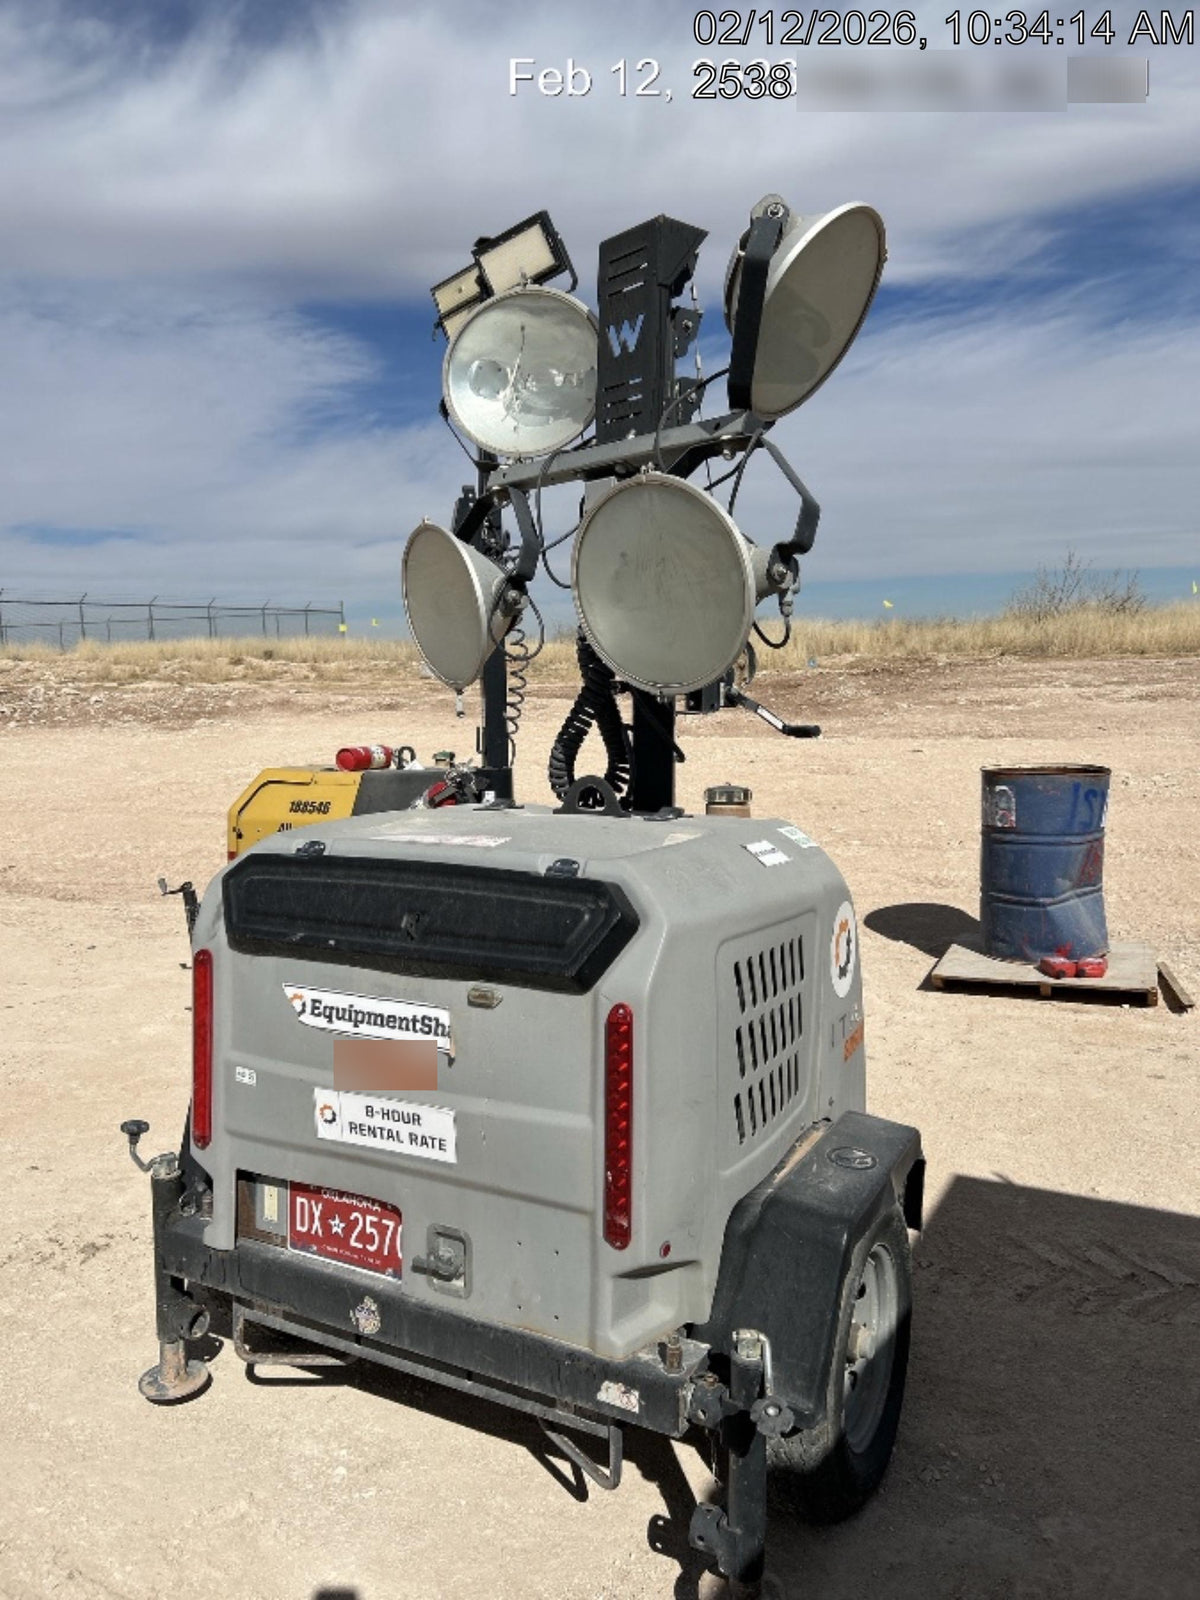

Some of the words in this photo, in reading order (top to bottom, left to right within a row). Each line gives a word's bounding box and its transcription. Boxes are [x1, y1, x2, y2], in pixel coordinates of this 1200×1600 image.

[289, 800, 331, 815] 188546
[310, 998, 451, 1038] EquipmentSh
[348, 1121, 404, 1144] RENTAL
[408, 1132, 447, 1153] RATE
[295, 1195, 323, 1237] DX
